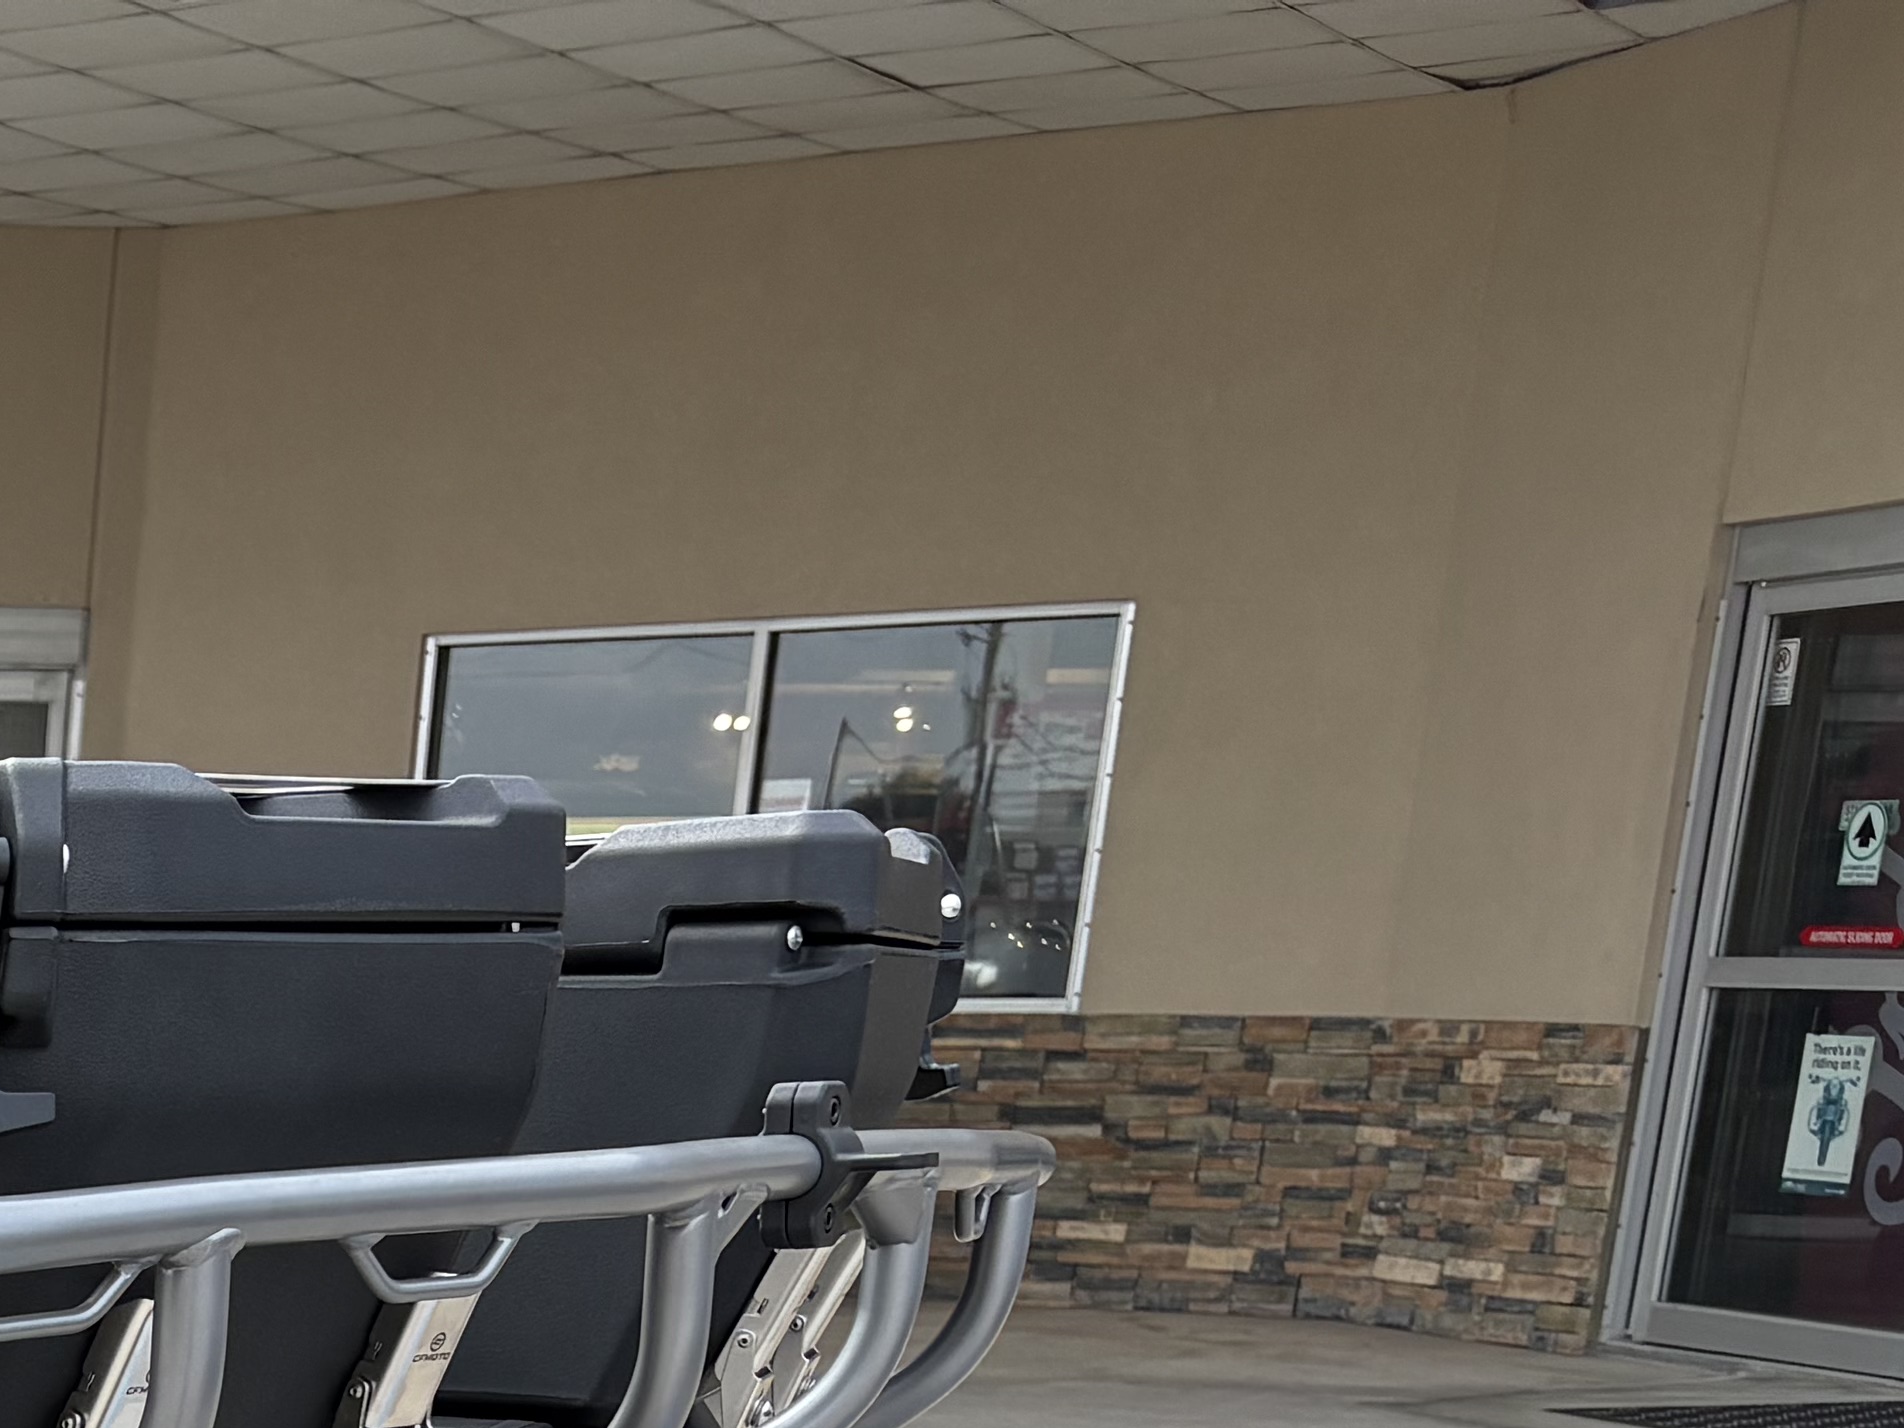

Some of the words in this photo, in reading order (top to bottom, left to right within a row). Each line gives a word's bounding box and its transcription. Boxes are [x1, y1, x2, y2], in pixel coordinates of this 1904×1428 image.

[1810, 931, 1846, 943] AUTOMATIC
[1847, 932, 1874, 943] SLIDING
[1875, 932, 1894, 944] DOOR
[1813, 1042, 1844, 1056] There's
[1846, 1046, 1851, 1056] a
[1811, 1057, 1839, 1071] riding
[1840, 1060, 1851, 1070] on
